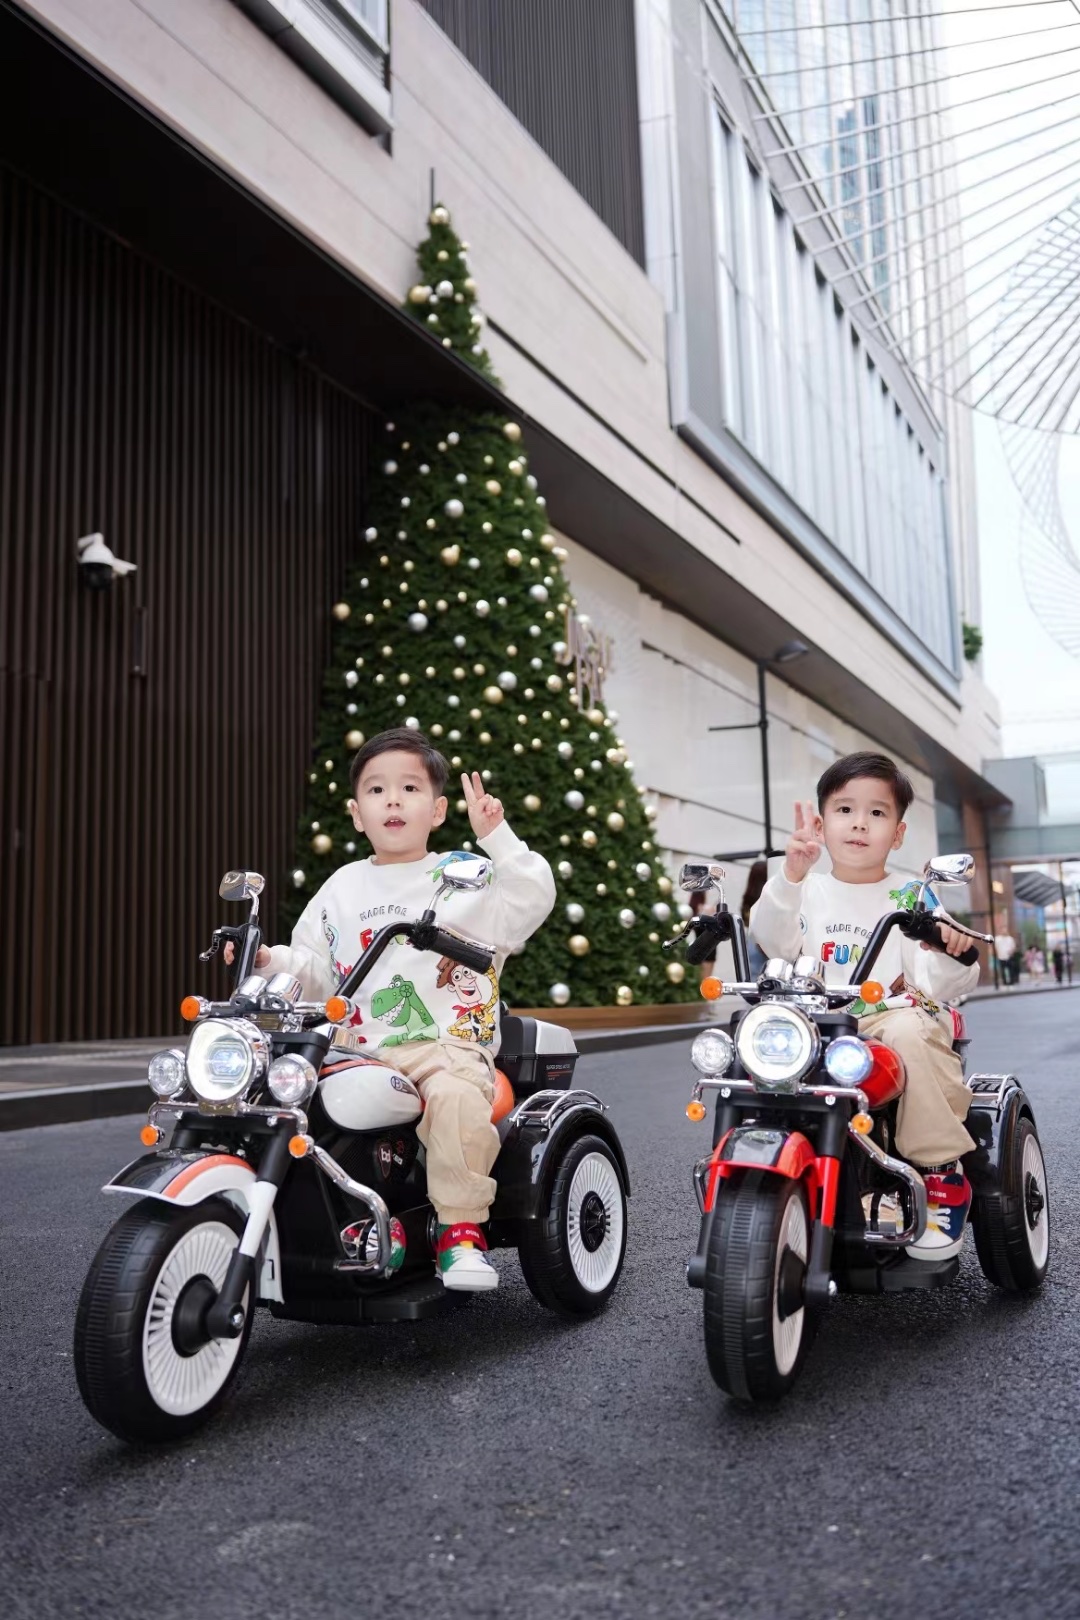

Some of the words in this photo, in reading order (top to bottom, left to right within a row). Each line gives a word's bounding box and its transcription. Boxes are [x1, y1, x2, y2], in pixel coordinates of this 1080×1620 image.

[360, 905, 385, 921] MADE
[388, 904, 407, 917] FOR
[826, 923, 852, 935] MADE
